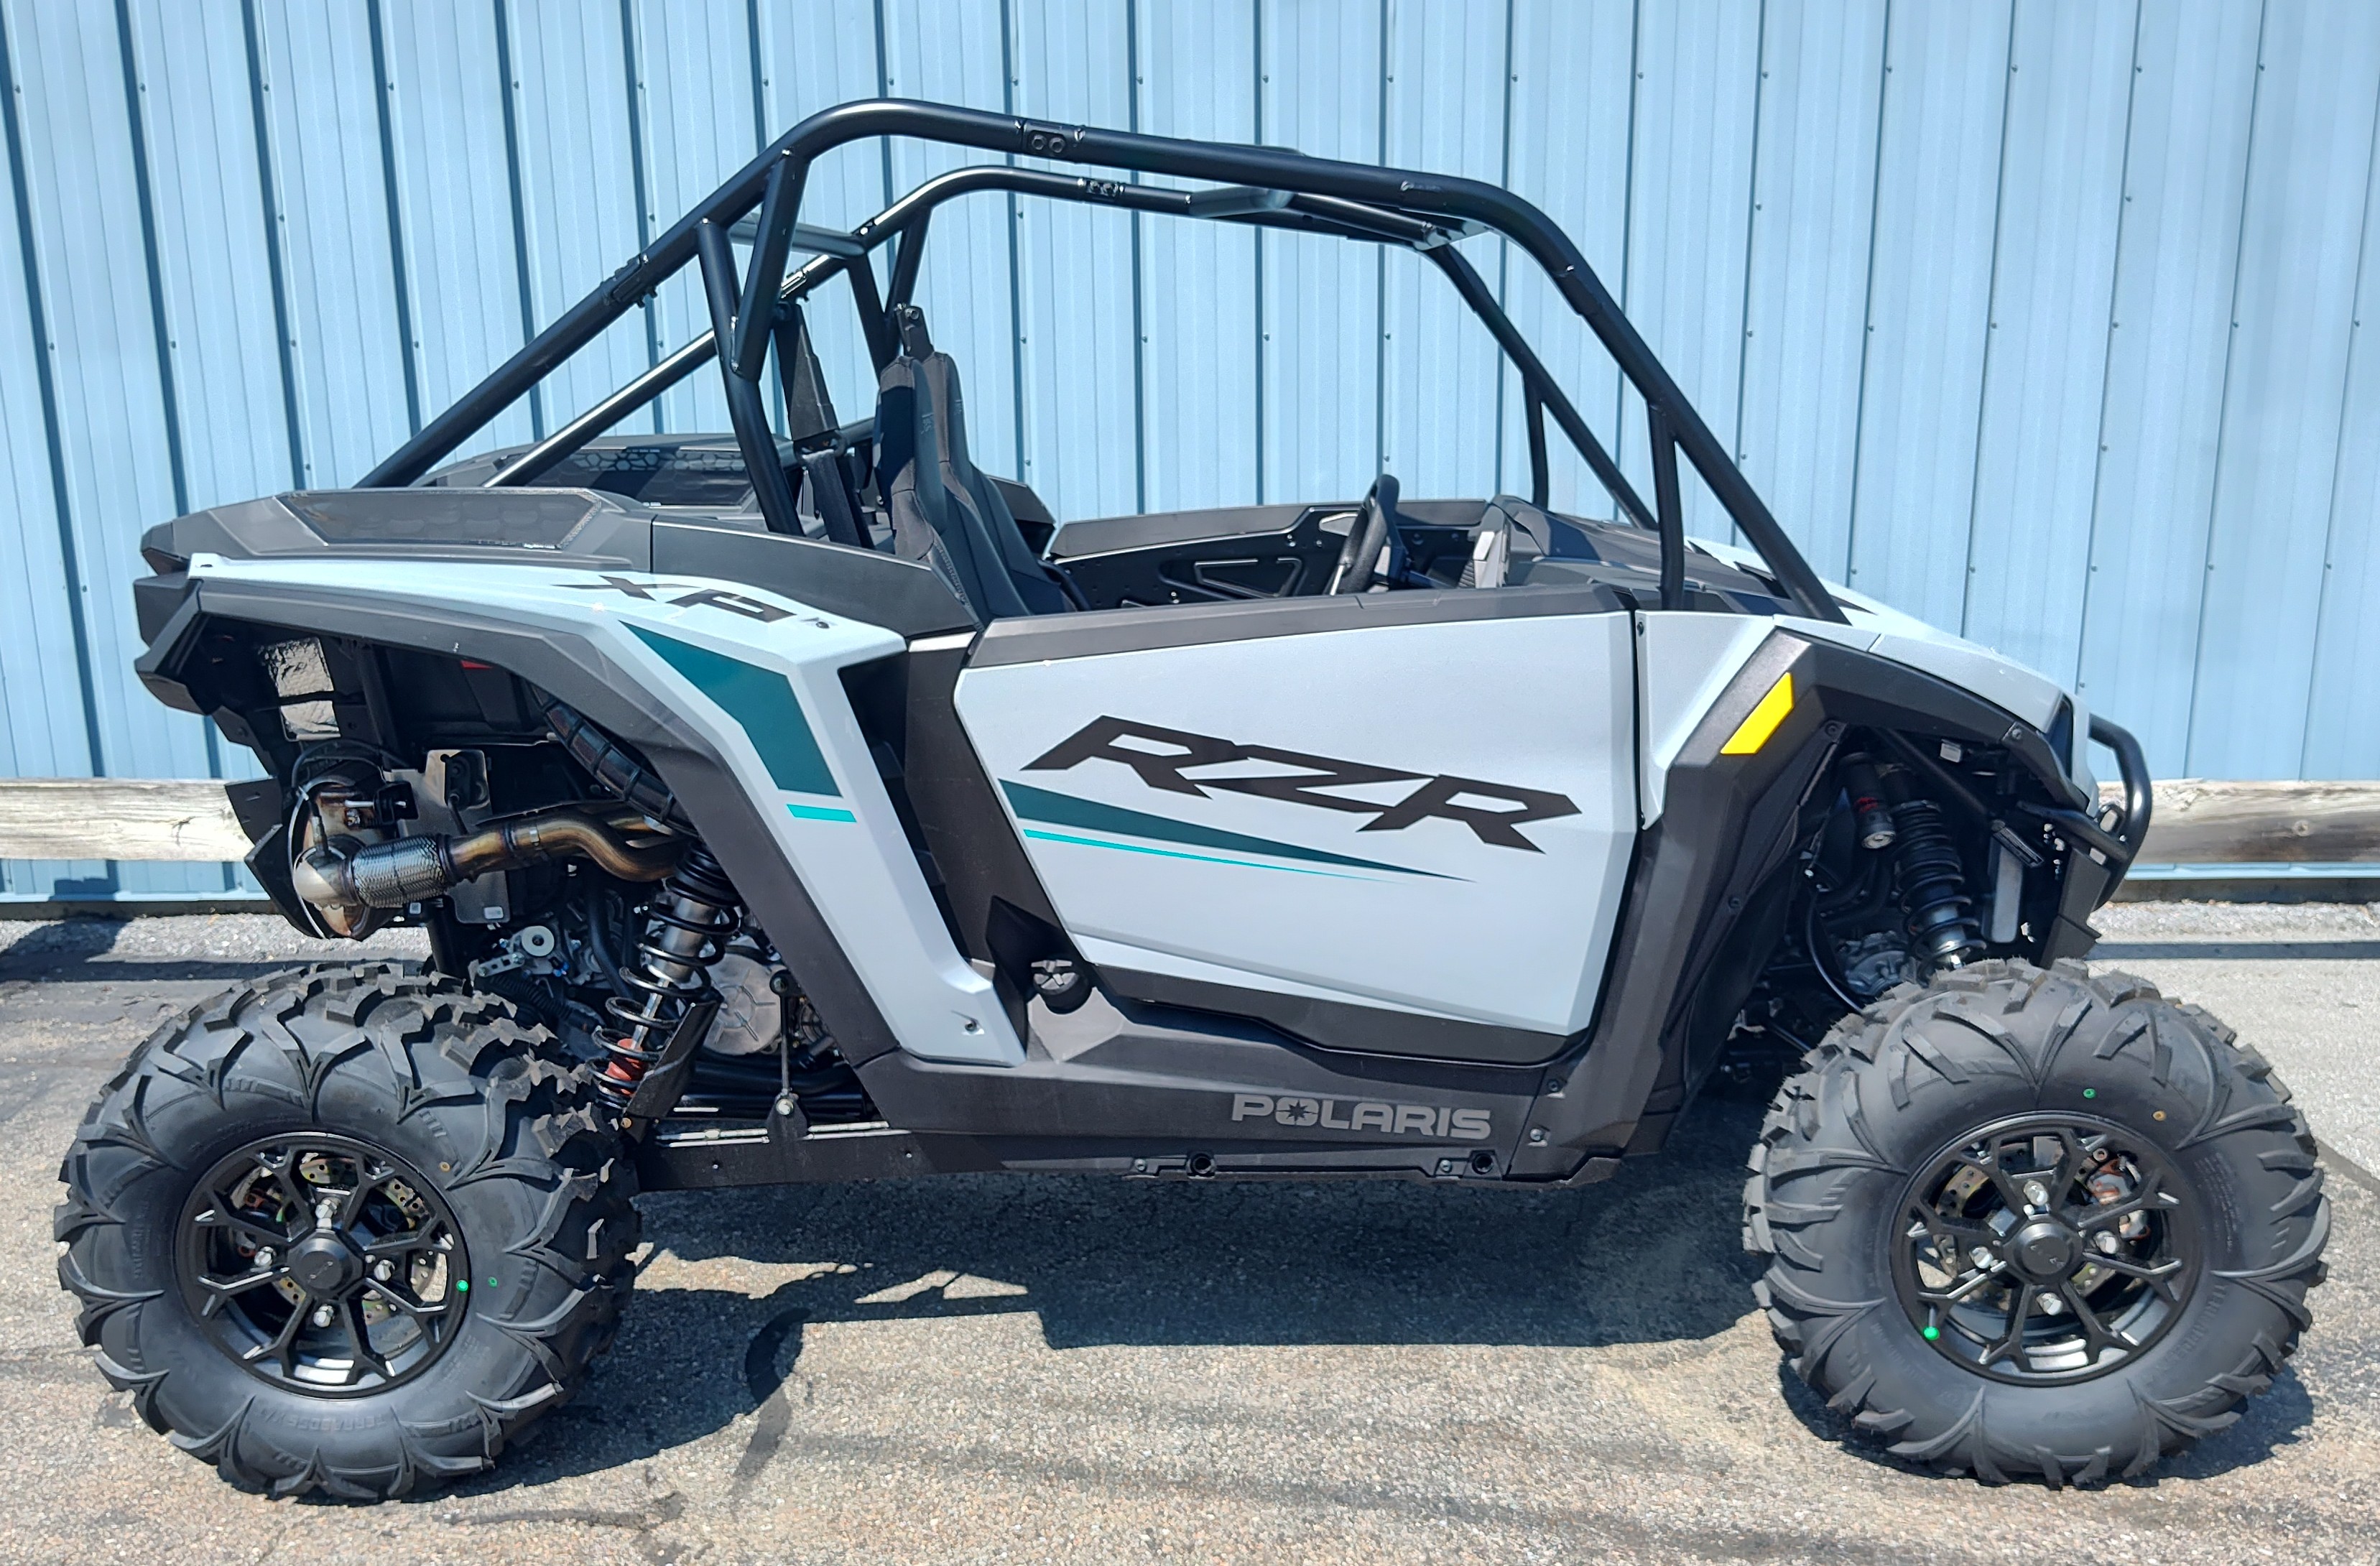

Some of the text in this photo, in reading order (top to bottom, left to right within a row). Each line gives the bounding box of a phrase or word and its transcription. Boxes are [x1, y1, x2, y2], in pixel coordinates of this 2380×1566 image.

[552, 575, 796, 622] XP
[1021, 715, 1582, 854] RZR
[1231, 1094, 1491, 1139] POLARIS
